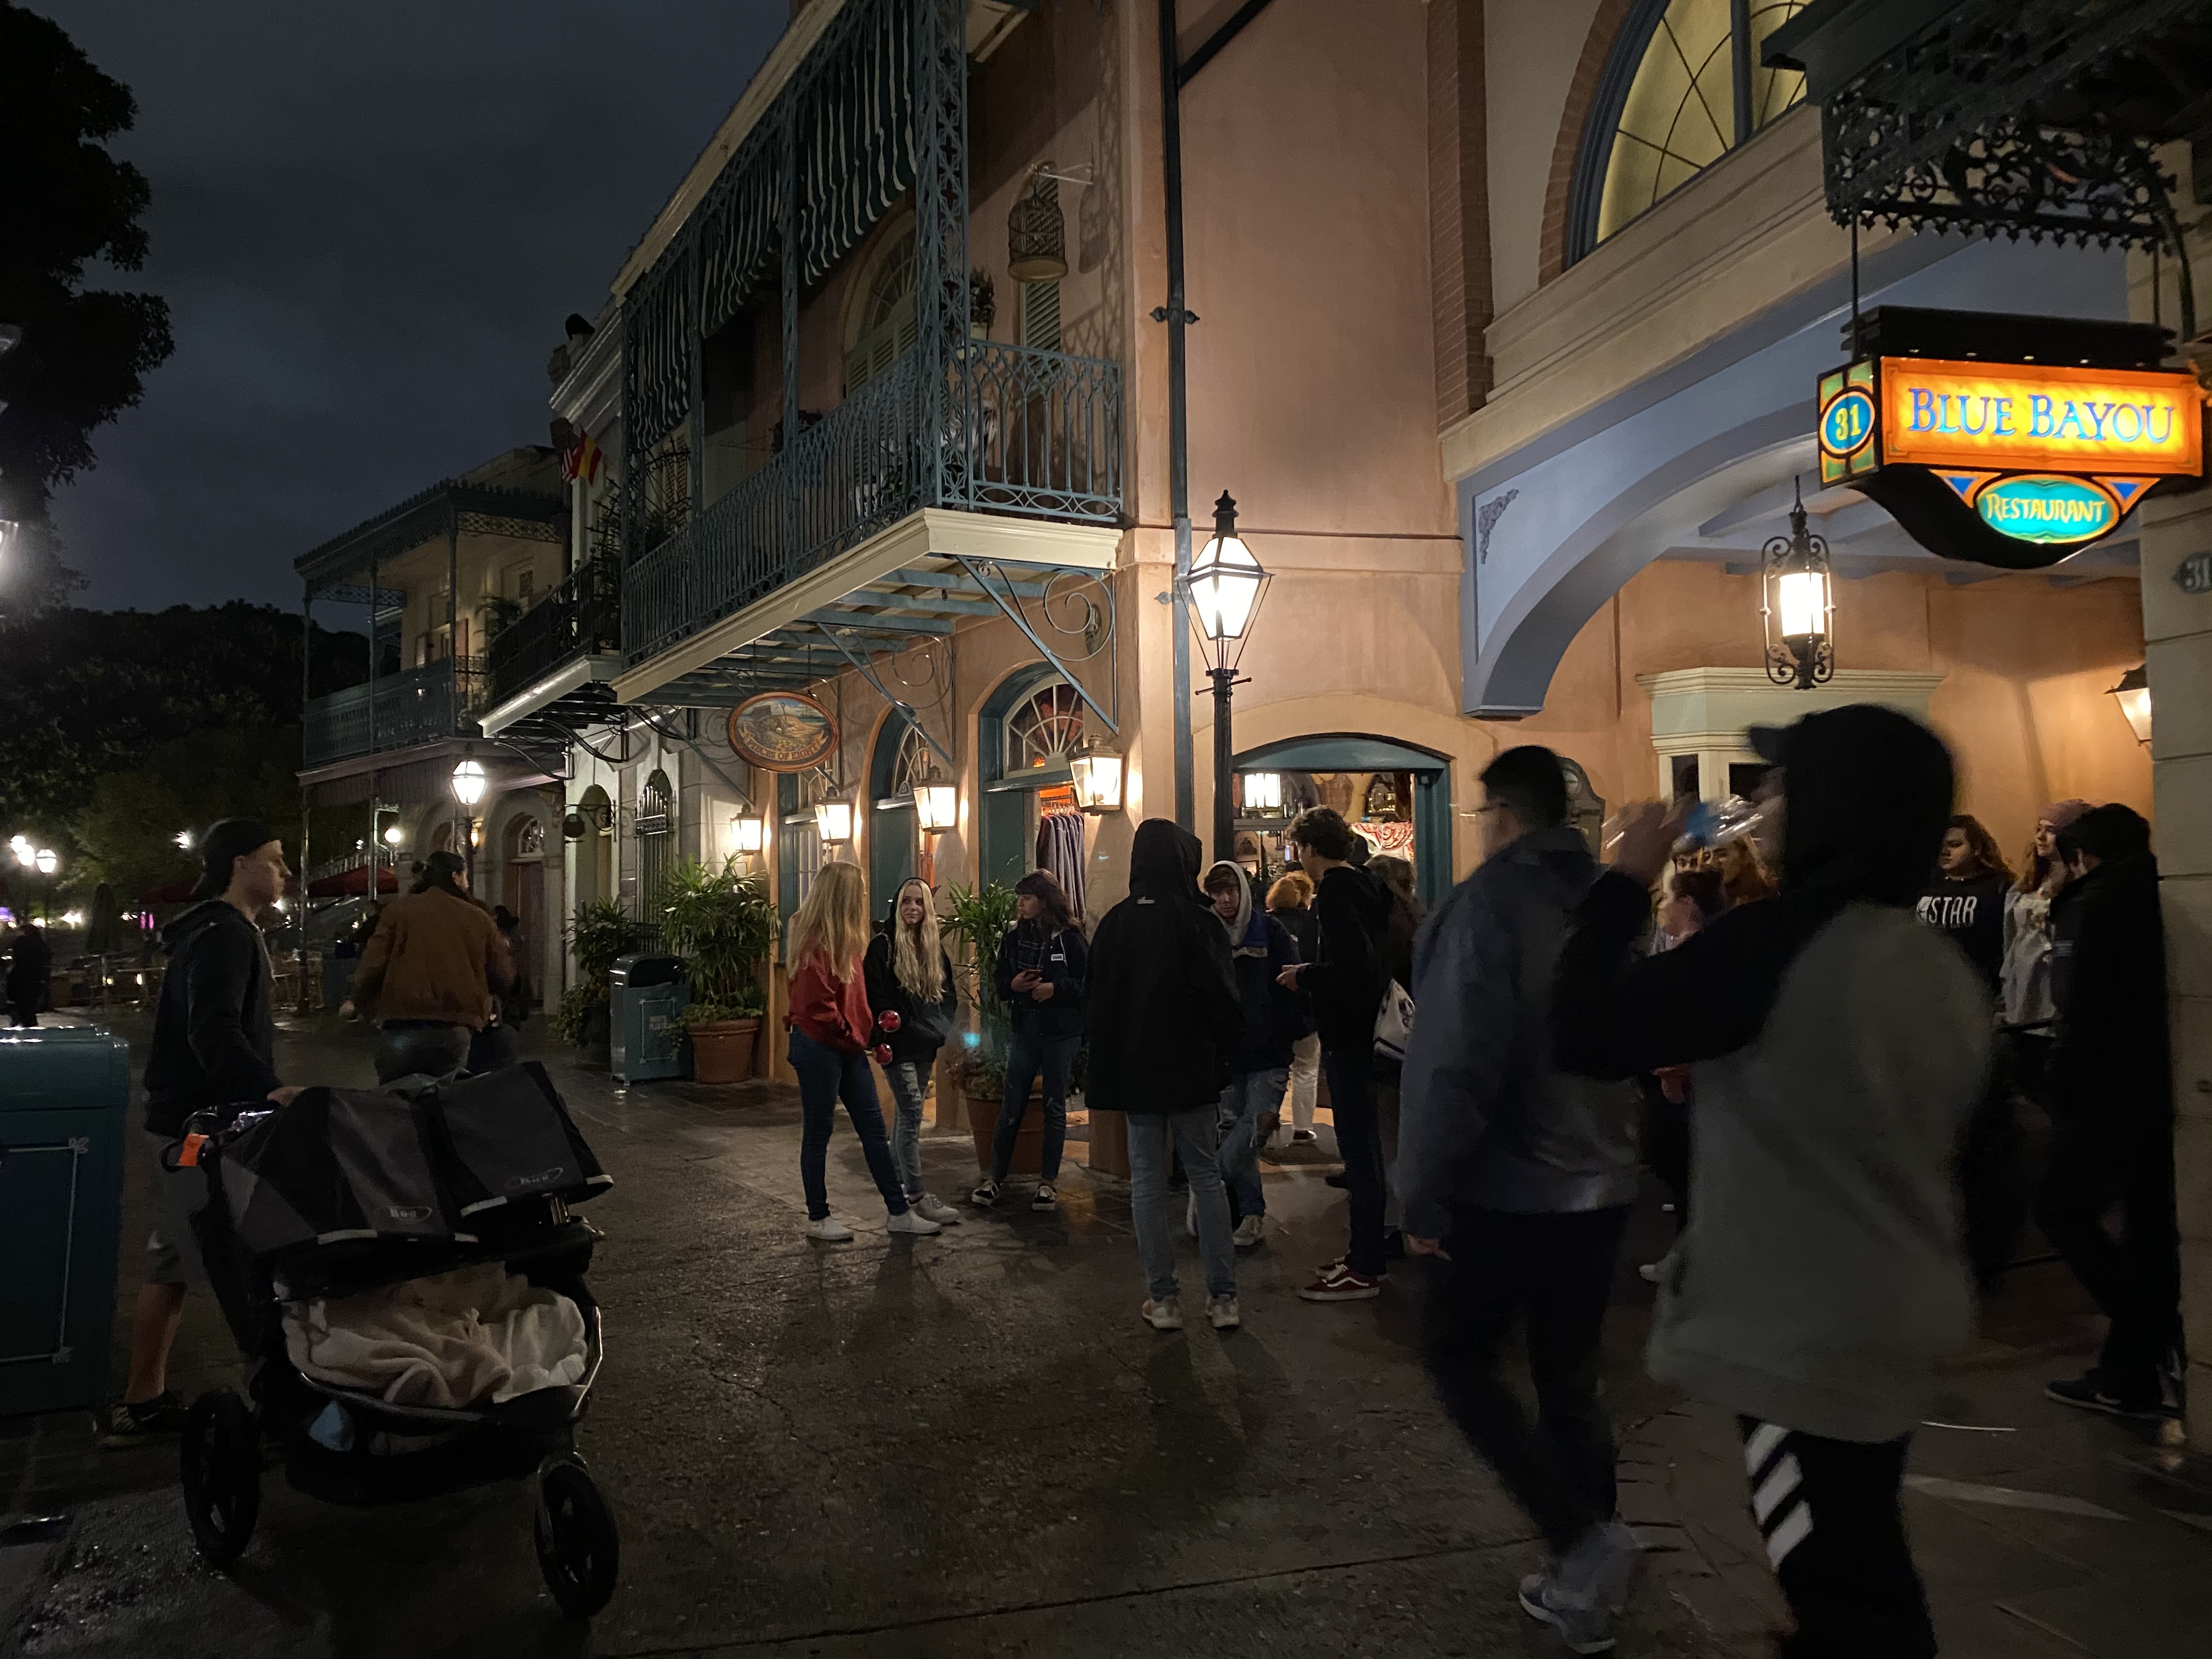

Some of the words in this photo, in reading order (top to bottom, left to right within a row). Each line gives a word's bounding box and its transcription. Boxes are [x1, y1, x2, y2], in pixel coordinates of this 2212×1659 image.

[1835, 404, 1861, 441] 31
[1908, 387, 2016, 436] BLUE
[2027, 394, 2176, 444] BAYOU
[1986, 493, 2106, 524] RESTAURANT
[747, 740, 776, 759] PIECES
[792, 741, 819, 759] EIGHT
